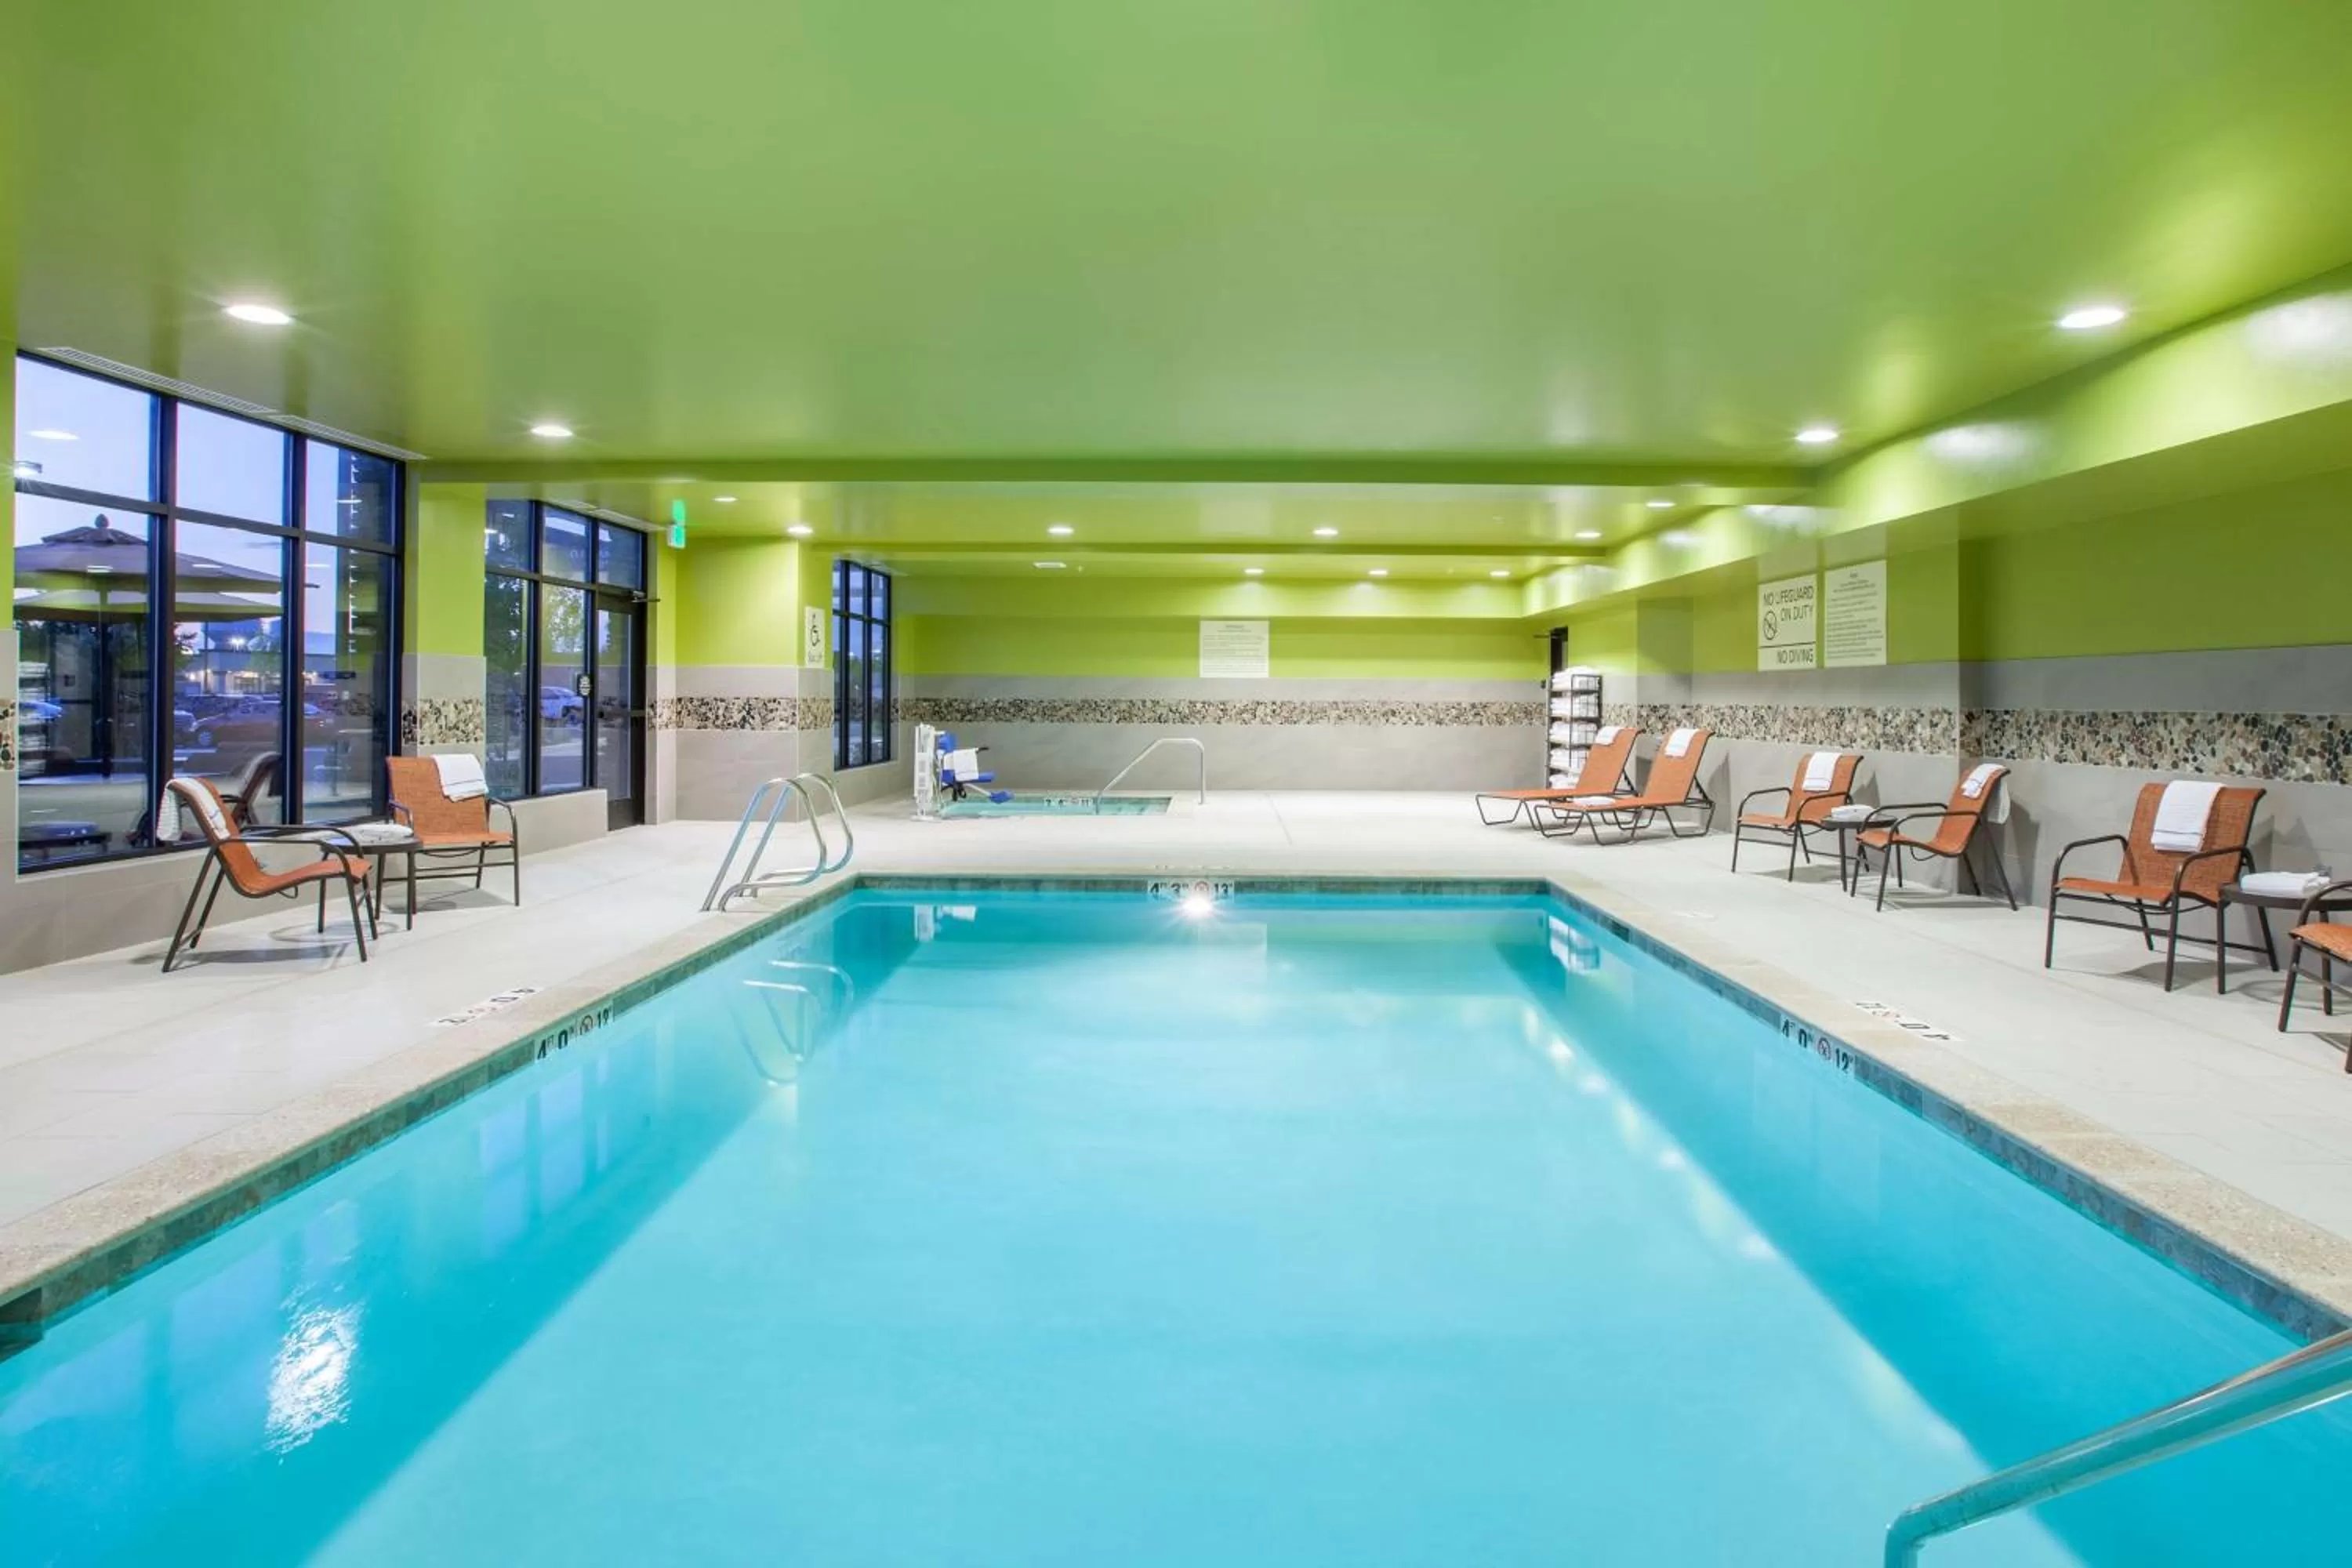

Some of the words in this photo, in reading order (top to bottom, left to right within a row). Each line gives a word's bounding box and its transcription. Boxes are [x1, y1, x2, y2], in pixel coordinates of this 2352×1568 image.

[1763, 591, 1774, 606] NO
[1776, 585, 1814, 604] LIFEGUARD
[1780, 608, 1791, 622] ON
[1793, 604, 1813, 620] DUTY
[1777, 650, 1788, 664] NO
[1789, 648, 1813, 663] DIVING
